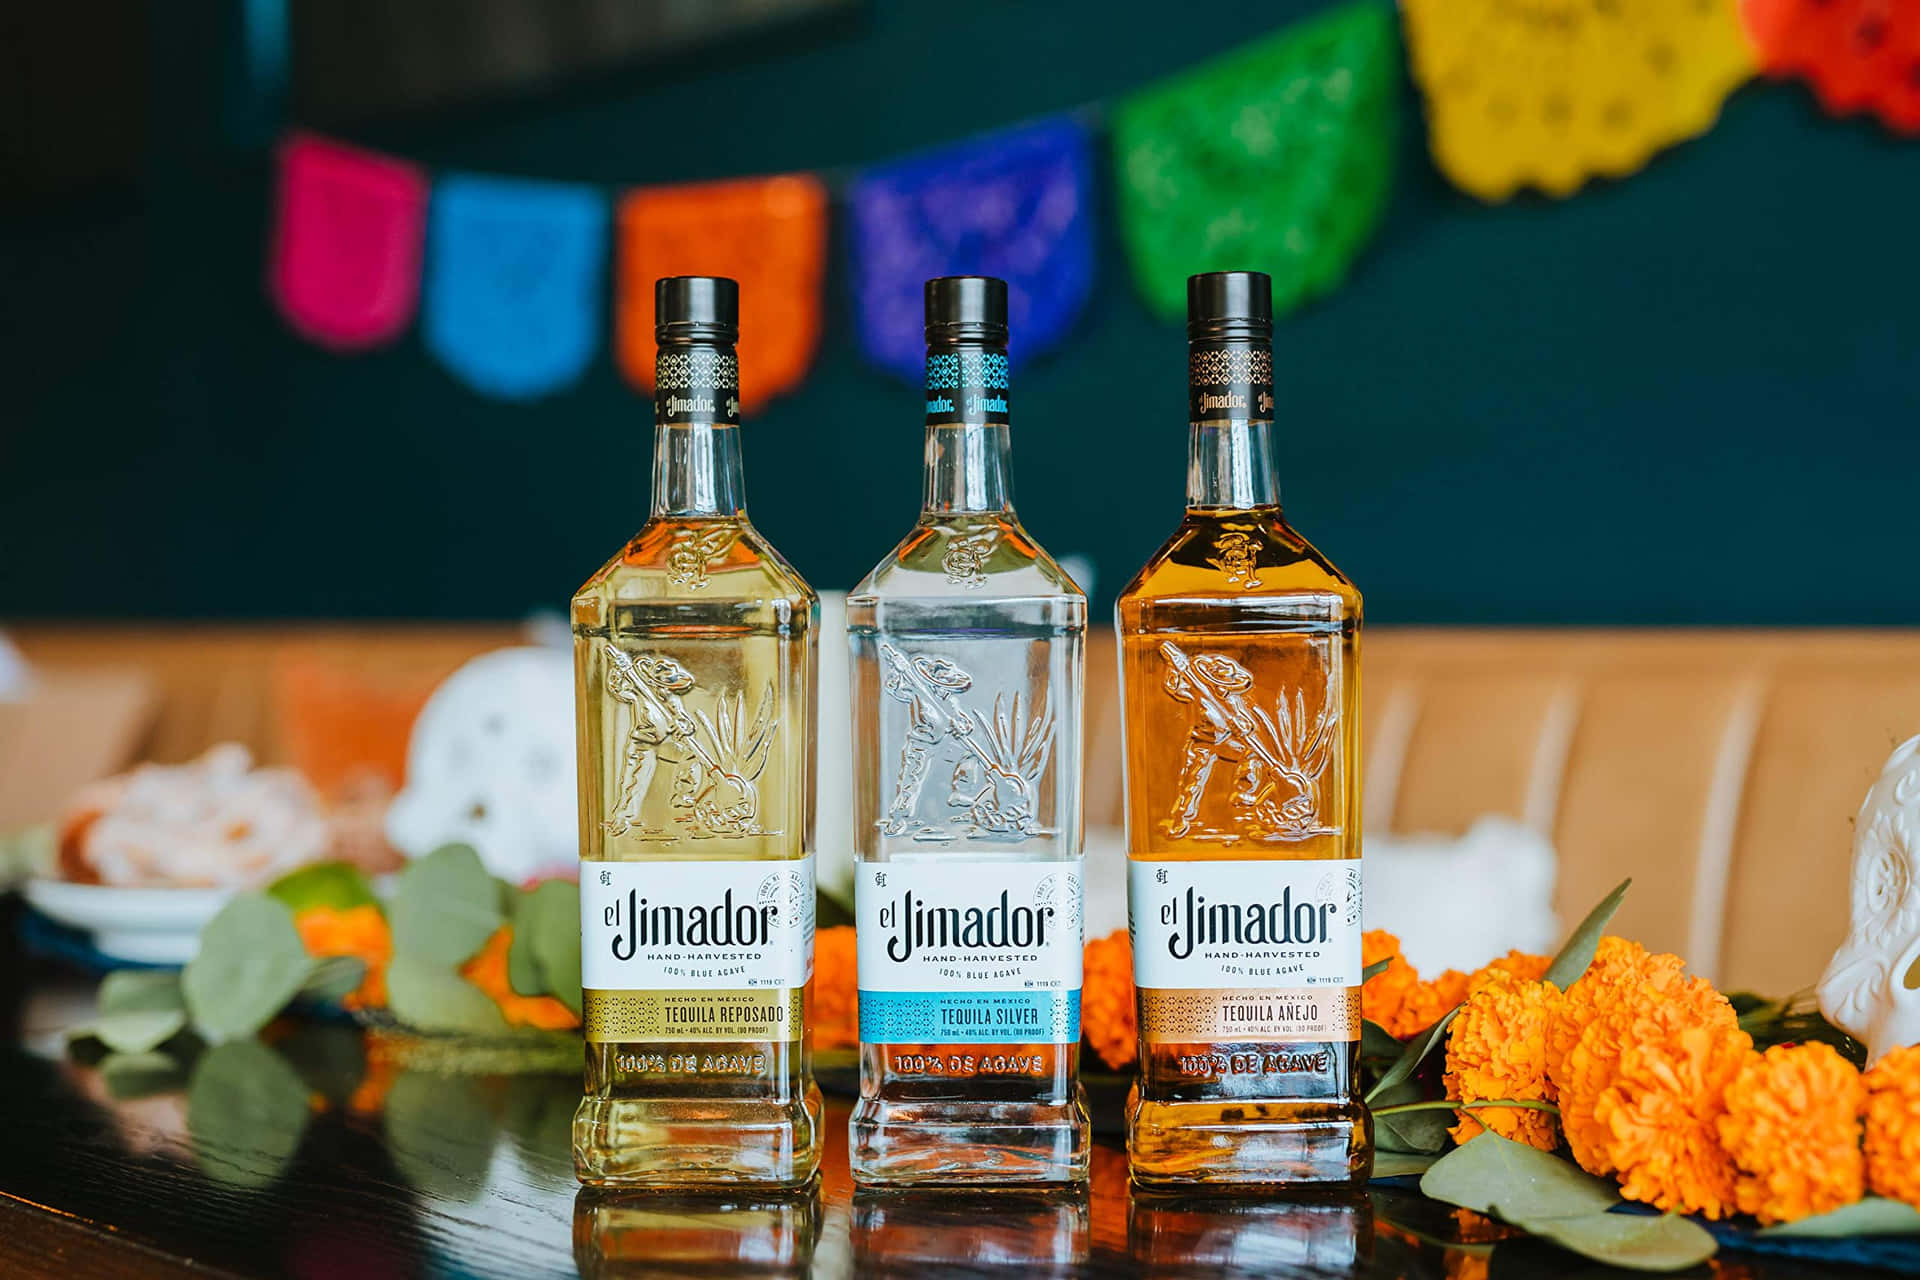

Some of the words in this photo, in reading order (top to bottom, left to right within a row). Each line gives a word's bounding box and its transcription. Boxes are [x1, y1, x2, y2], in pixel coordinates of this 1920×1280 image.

[668, 394, 714, 417] Jimador
[1200, 390, 1245, 414] Jimador
[604, 899, 620, 927] el
[1161, 897, 1177, 925] el
[611, 888, 778, 961] Jimador
[879, 900, 895, 928] el
[887, 889, 1054, 962] Jimador
[1168, 886, 1336, 960] Jimador
[664, 966, 686, 976] 100%
[690, 969, 712, 978] BLUE
[718, 966, 744, 976] AGAVE
[939, 968, 961, 978] 100%
[994, 967, 1022, 978] AGAVE
[1221, 965, 1243, 975] 100%
[1249, 968, 1270, 976] BLUE
[1276, 964, 1304, 975] AGAVE
[665, 1006, 715, 1023] TEQUILA
[720, 1006, 784, 1023] REPOSADO
[942, 1008, 991, 1024] TEQUILA
[996, 1008, 1038, 1024] SILVER
[1222, 1005, 1273, 1022] TEQUILA
[1278, 1002, 1318, 1021] AÑEJO
[665, 1026, 675, 1034] 750
[690, 1026, 701, 1034] 40%
[716, 1026, 722, 1034] BY
[616, 1054, 666, 1073] 100%
[669, 1055, 697, 1073] DE
[700, 1055, 766, 1073] AGAVE
[894, 1055, 944, 1073] 100%
[949, 1056, 975, 1073] DE
[978, 1056, 1043, 1073] AGAVE
[1178, 1055, 1228, 1074] 100%
[1230, 1054, 1258, 1074] DE
[1262, 1053, 1329, 1074] AGAVE
